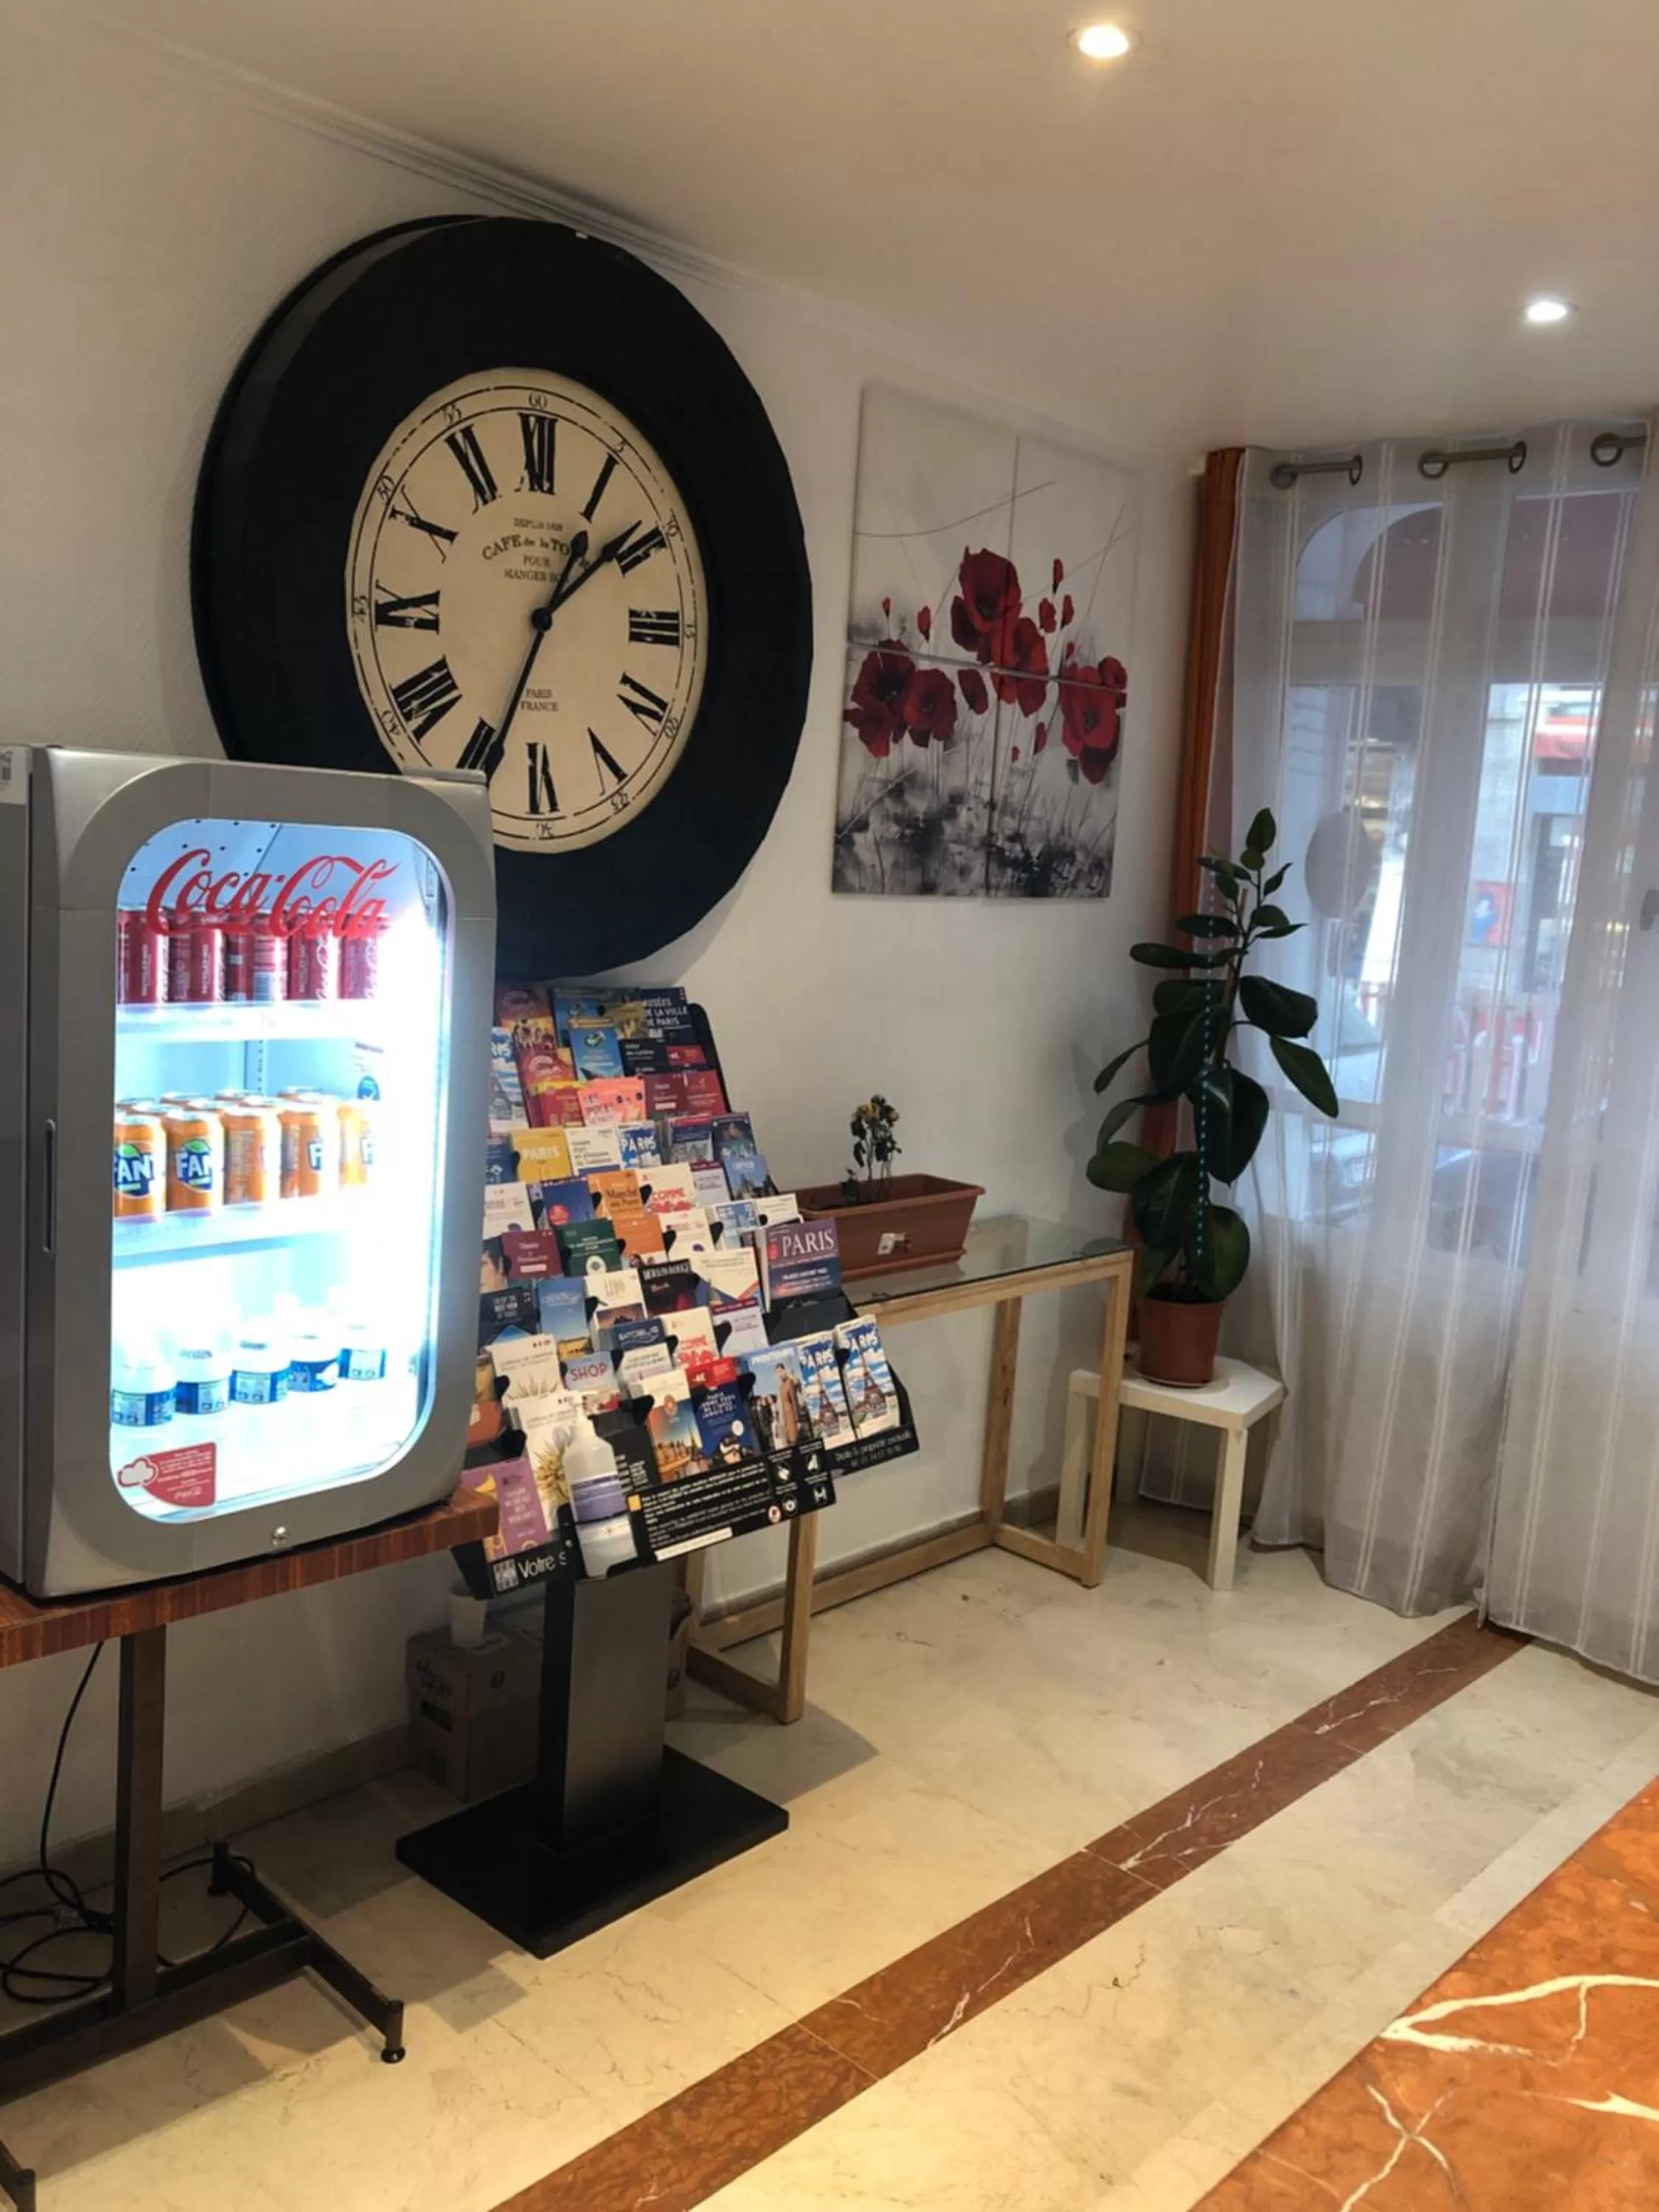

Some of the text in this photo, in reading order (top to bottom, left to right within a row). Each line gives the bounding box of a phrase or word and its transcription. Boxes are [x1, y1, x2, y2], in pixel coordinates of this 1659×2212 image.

[524, 554, 551, 567] POUR
[504, 568, 546, 582] MANGER
[526, 689, 552, 699] PARIS
[521, 701, 560, 712] FRANCE
[147, 849, 401, 939] Coca-Cola
[621, 1135, 656, 1152] PARIS
[521, 1146, 560, 1160] PARIS
[782, 1230, 835, 1257] PARIS
[571, 1363, 608, 1381] SHOP
[517, 1555, 555, 1579] Votre
